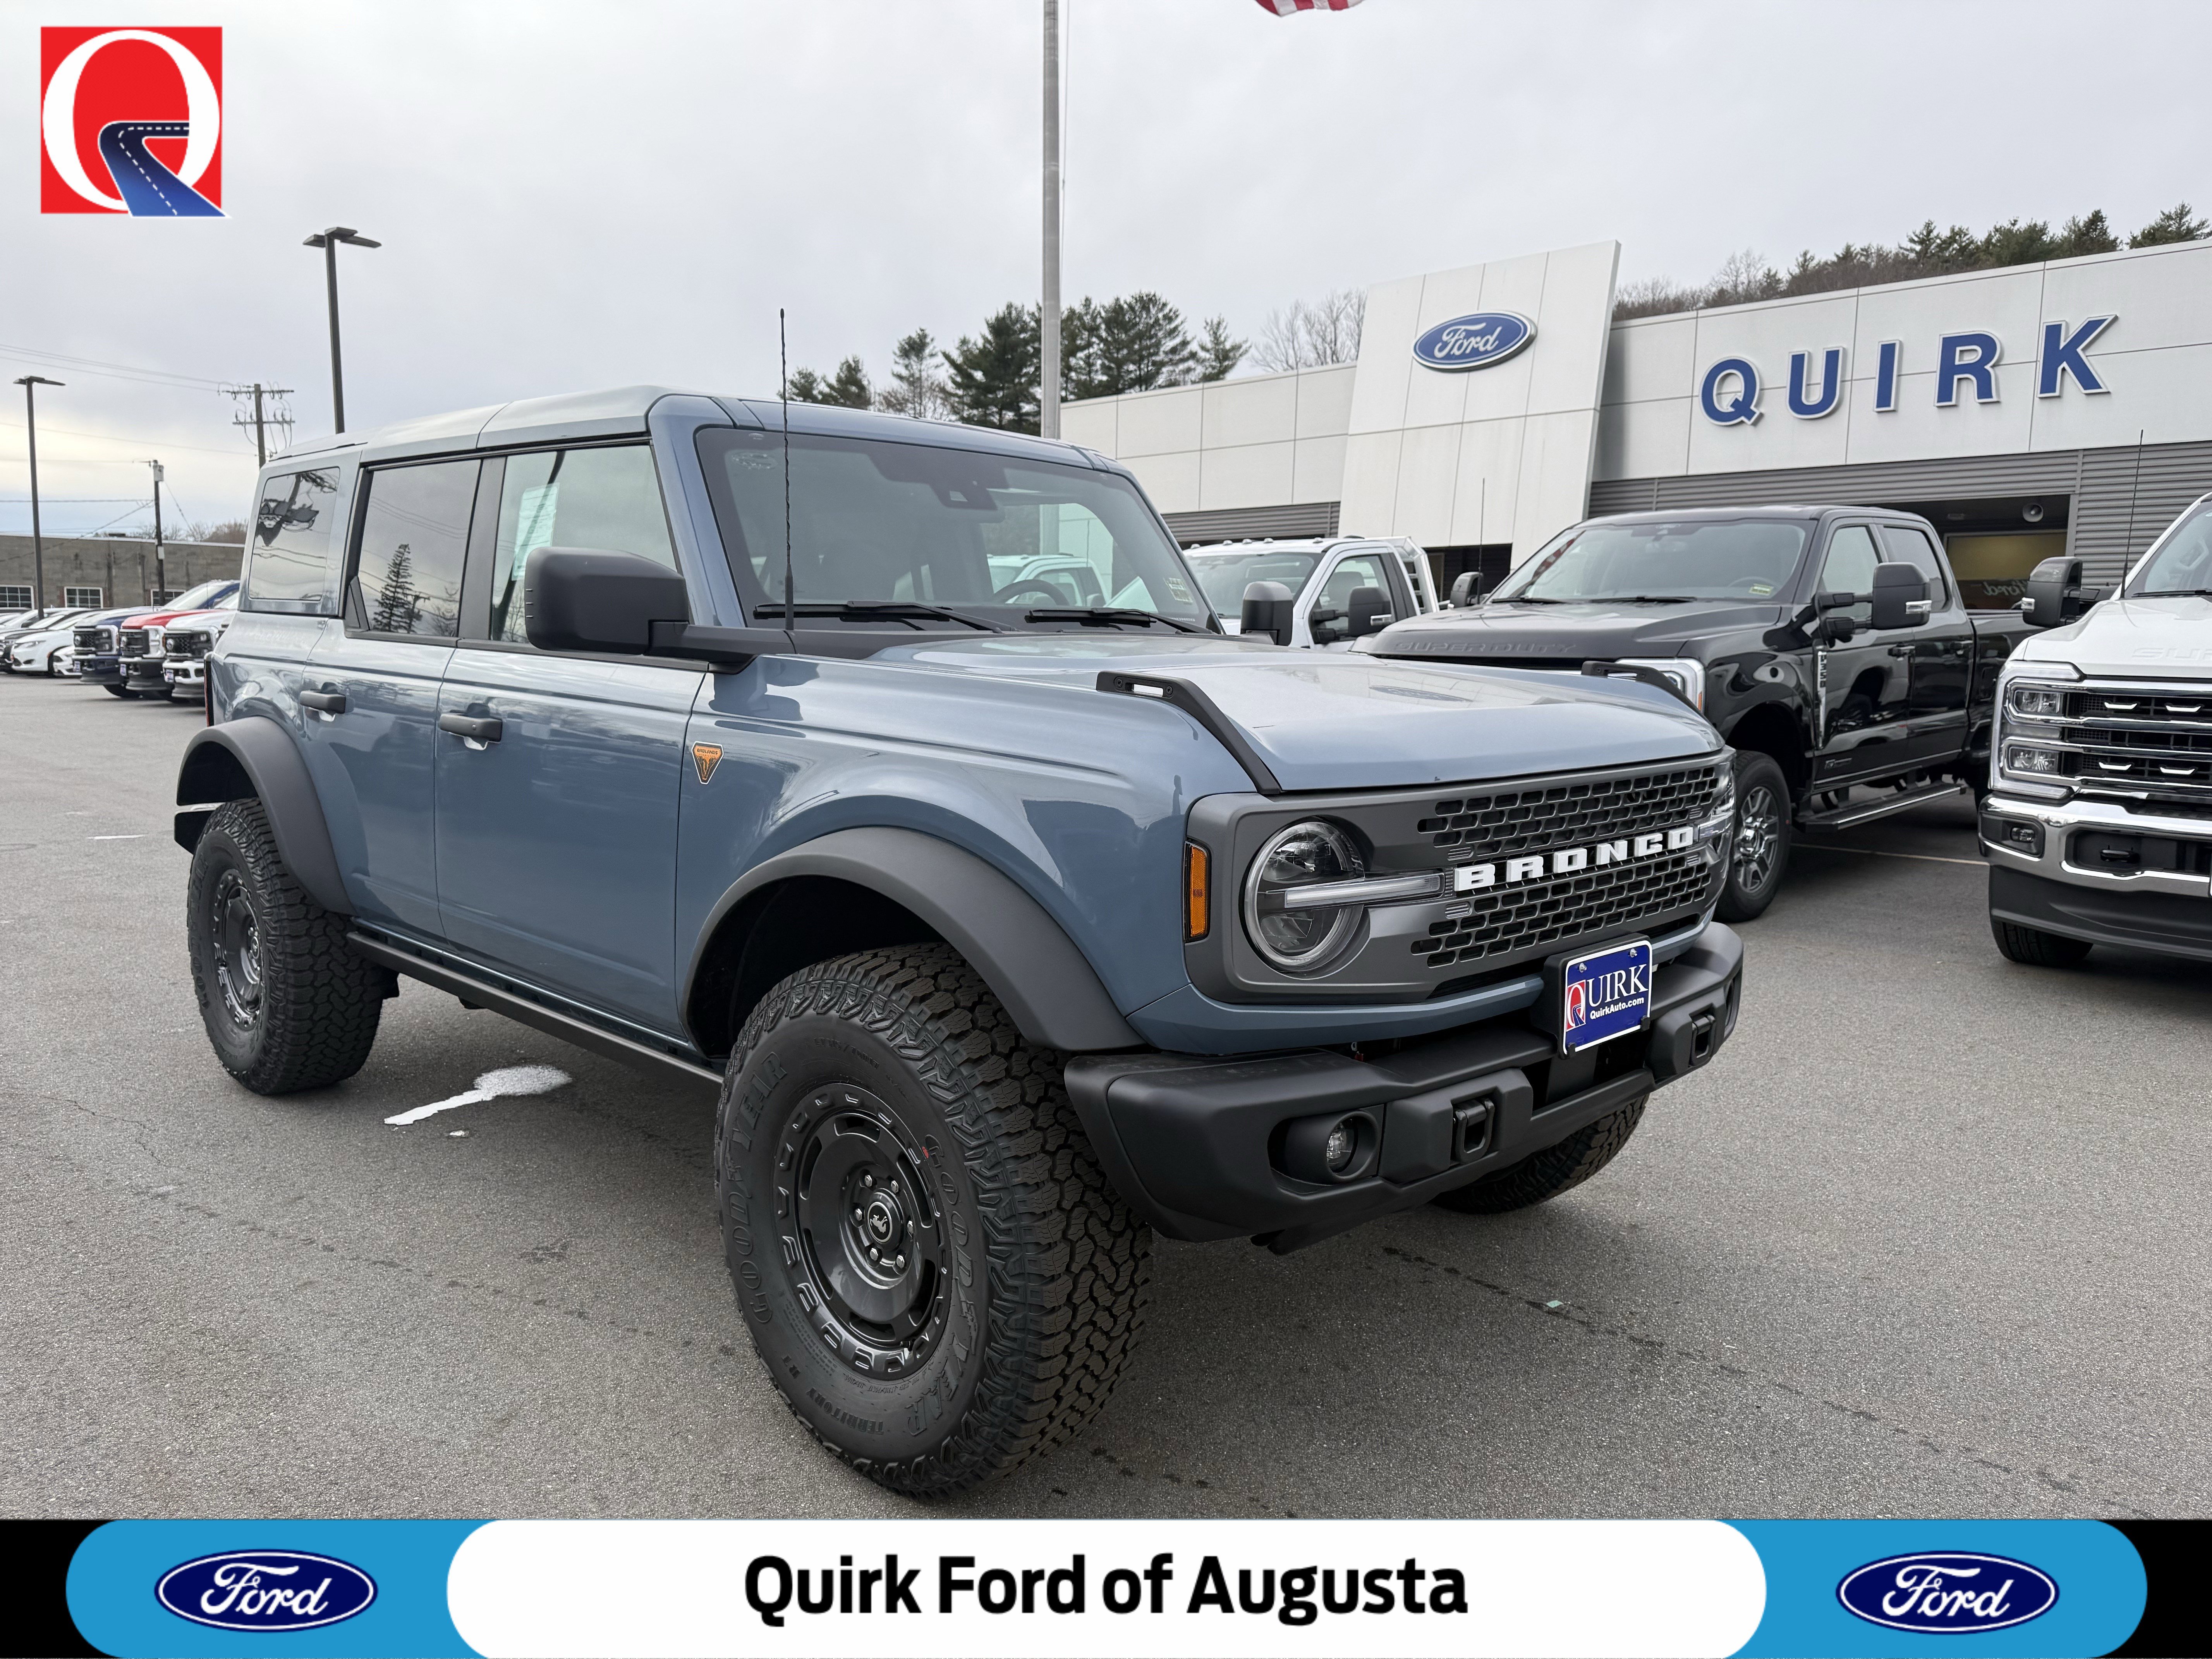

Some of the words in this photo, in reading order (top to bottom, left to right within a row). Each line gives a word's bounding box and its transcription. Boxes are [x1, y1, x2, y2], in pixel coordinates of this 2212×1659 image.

[1434, 322, 1503, 358] Ford
[1699, 314, 2118, 427] QUIRK
[1395, 642, 1486, 652] SUPER
[1490, 643, 1576, 653] DUTY
[2131, 647, 2212, 661] SU
[1454, 826, 1693, 892] BRONCO
[1567, 964, 1649, 1027] QUIRK
[1590, 997, 1644, 1020] QuirkAuto.com
[724, 1051, 787, 1323] GOODYEAR
[904, 1134, 979, 1437] GOODYEAR
[806, 1387, 884, 1435] TERRITORY
